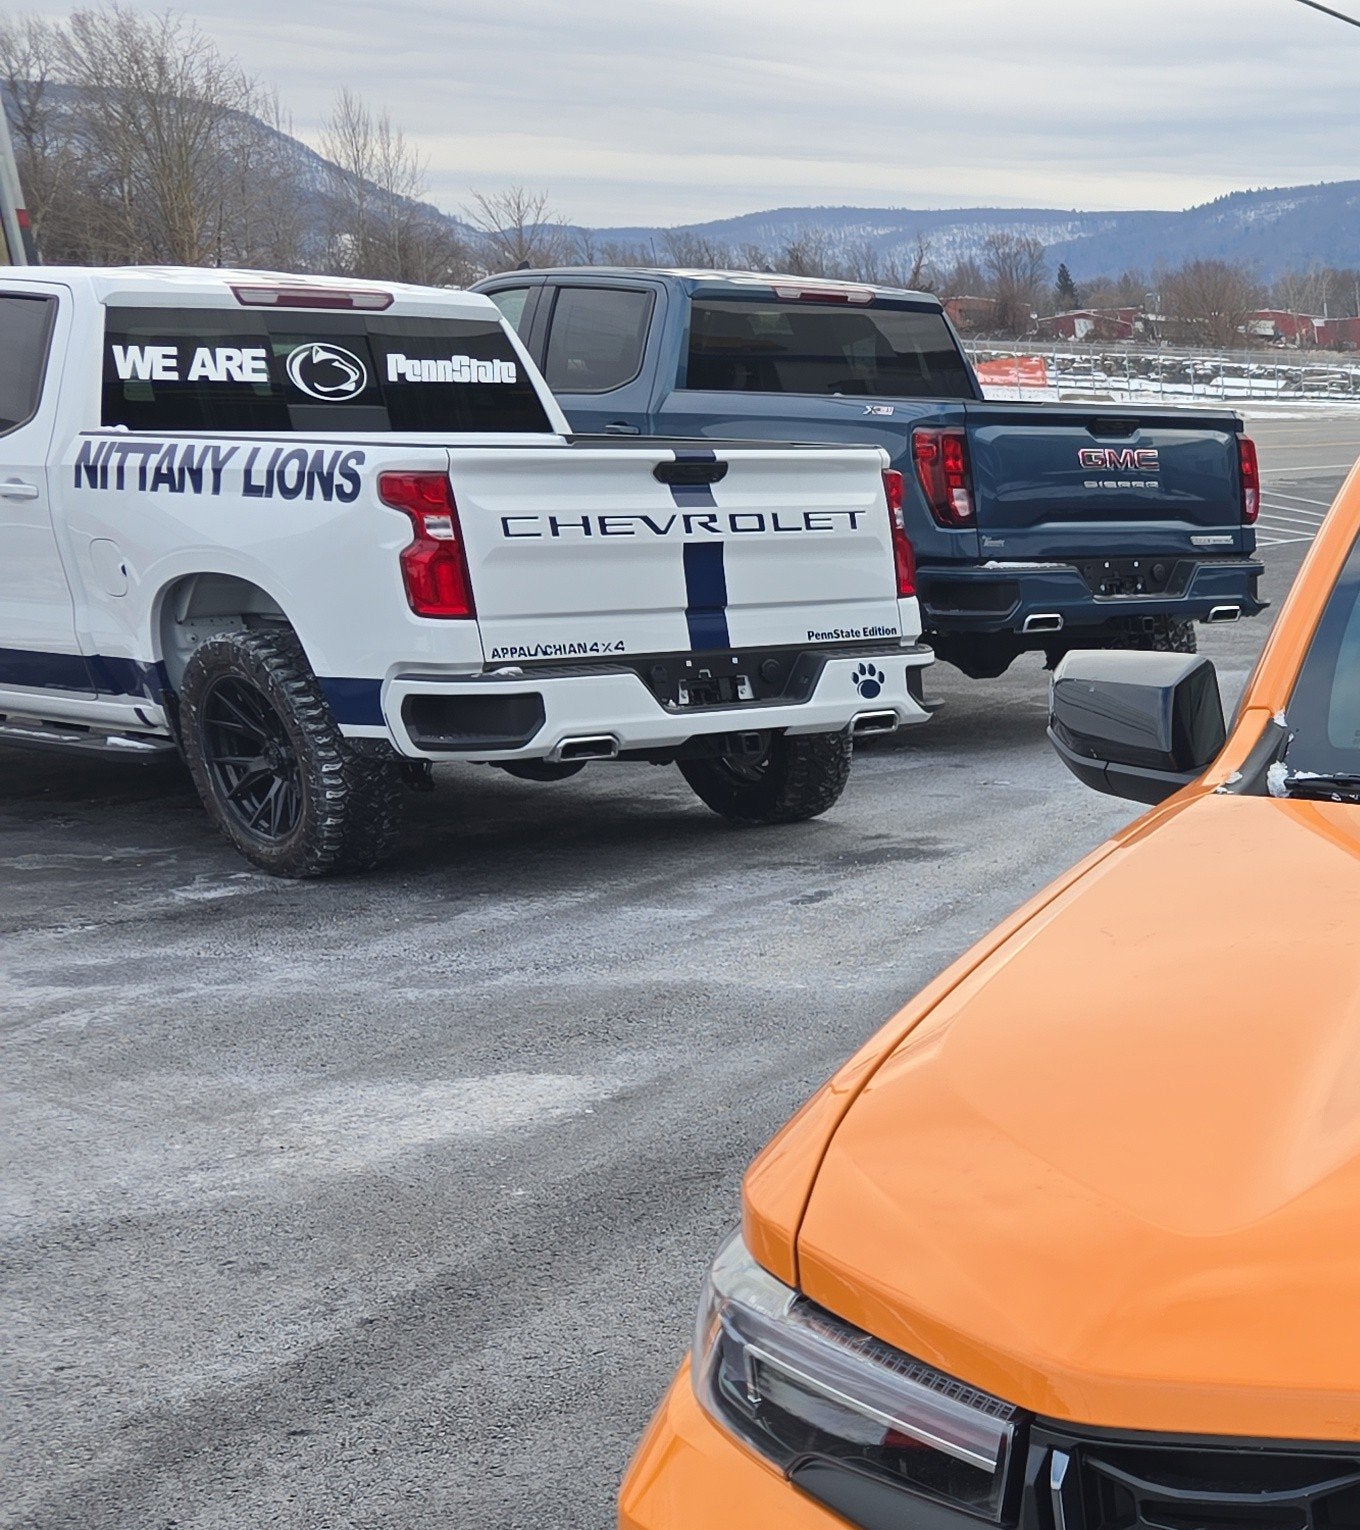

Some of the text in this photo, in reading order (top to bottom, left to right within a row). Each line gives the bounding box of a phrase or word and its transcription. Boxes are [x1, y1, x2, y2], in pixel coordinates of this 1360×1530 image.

[112, 345, 267, 382] WE ARE
[387, 353, 516, 384] PennState
[74, 440, 366, 503] NITTANY LIONS
[1078, 448, 1160, 471] GMC
[501, 510, 866, 538] CHEVROLET
[807, 626, 897, 641] PennState Edition
[491, 643, 588, 659] APPALACHIAN
